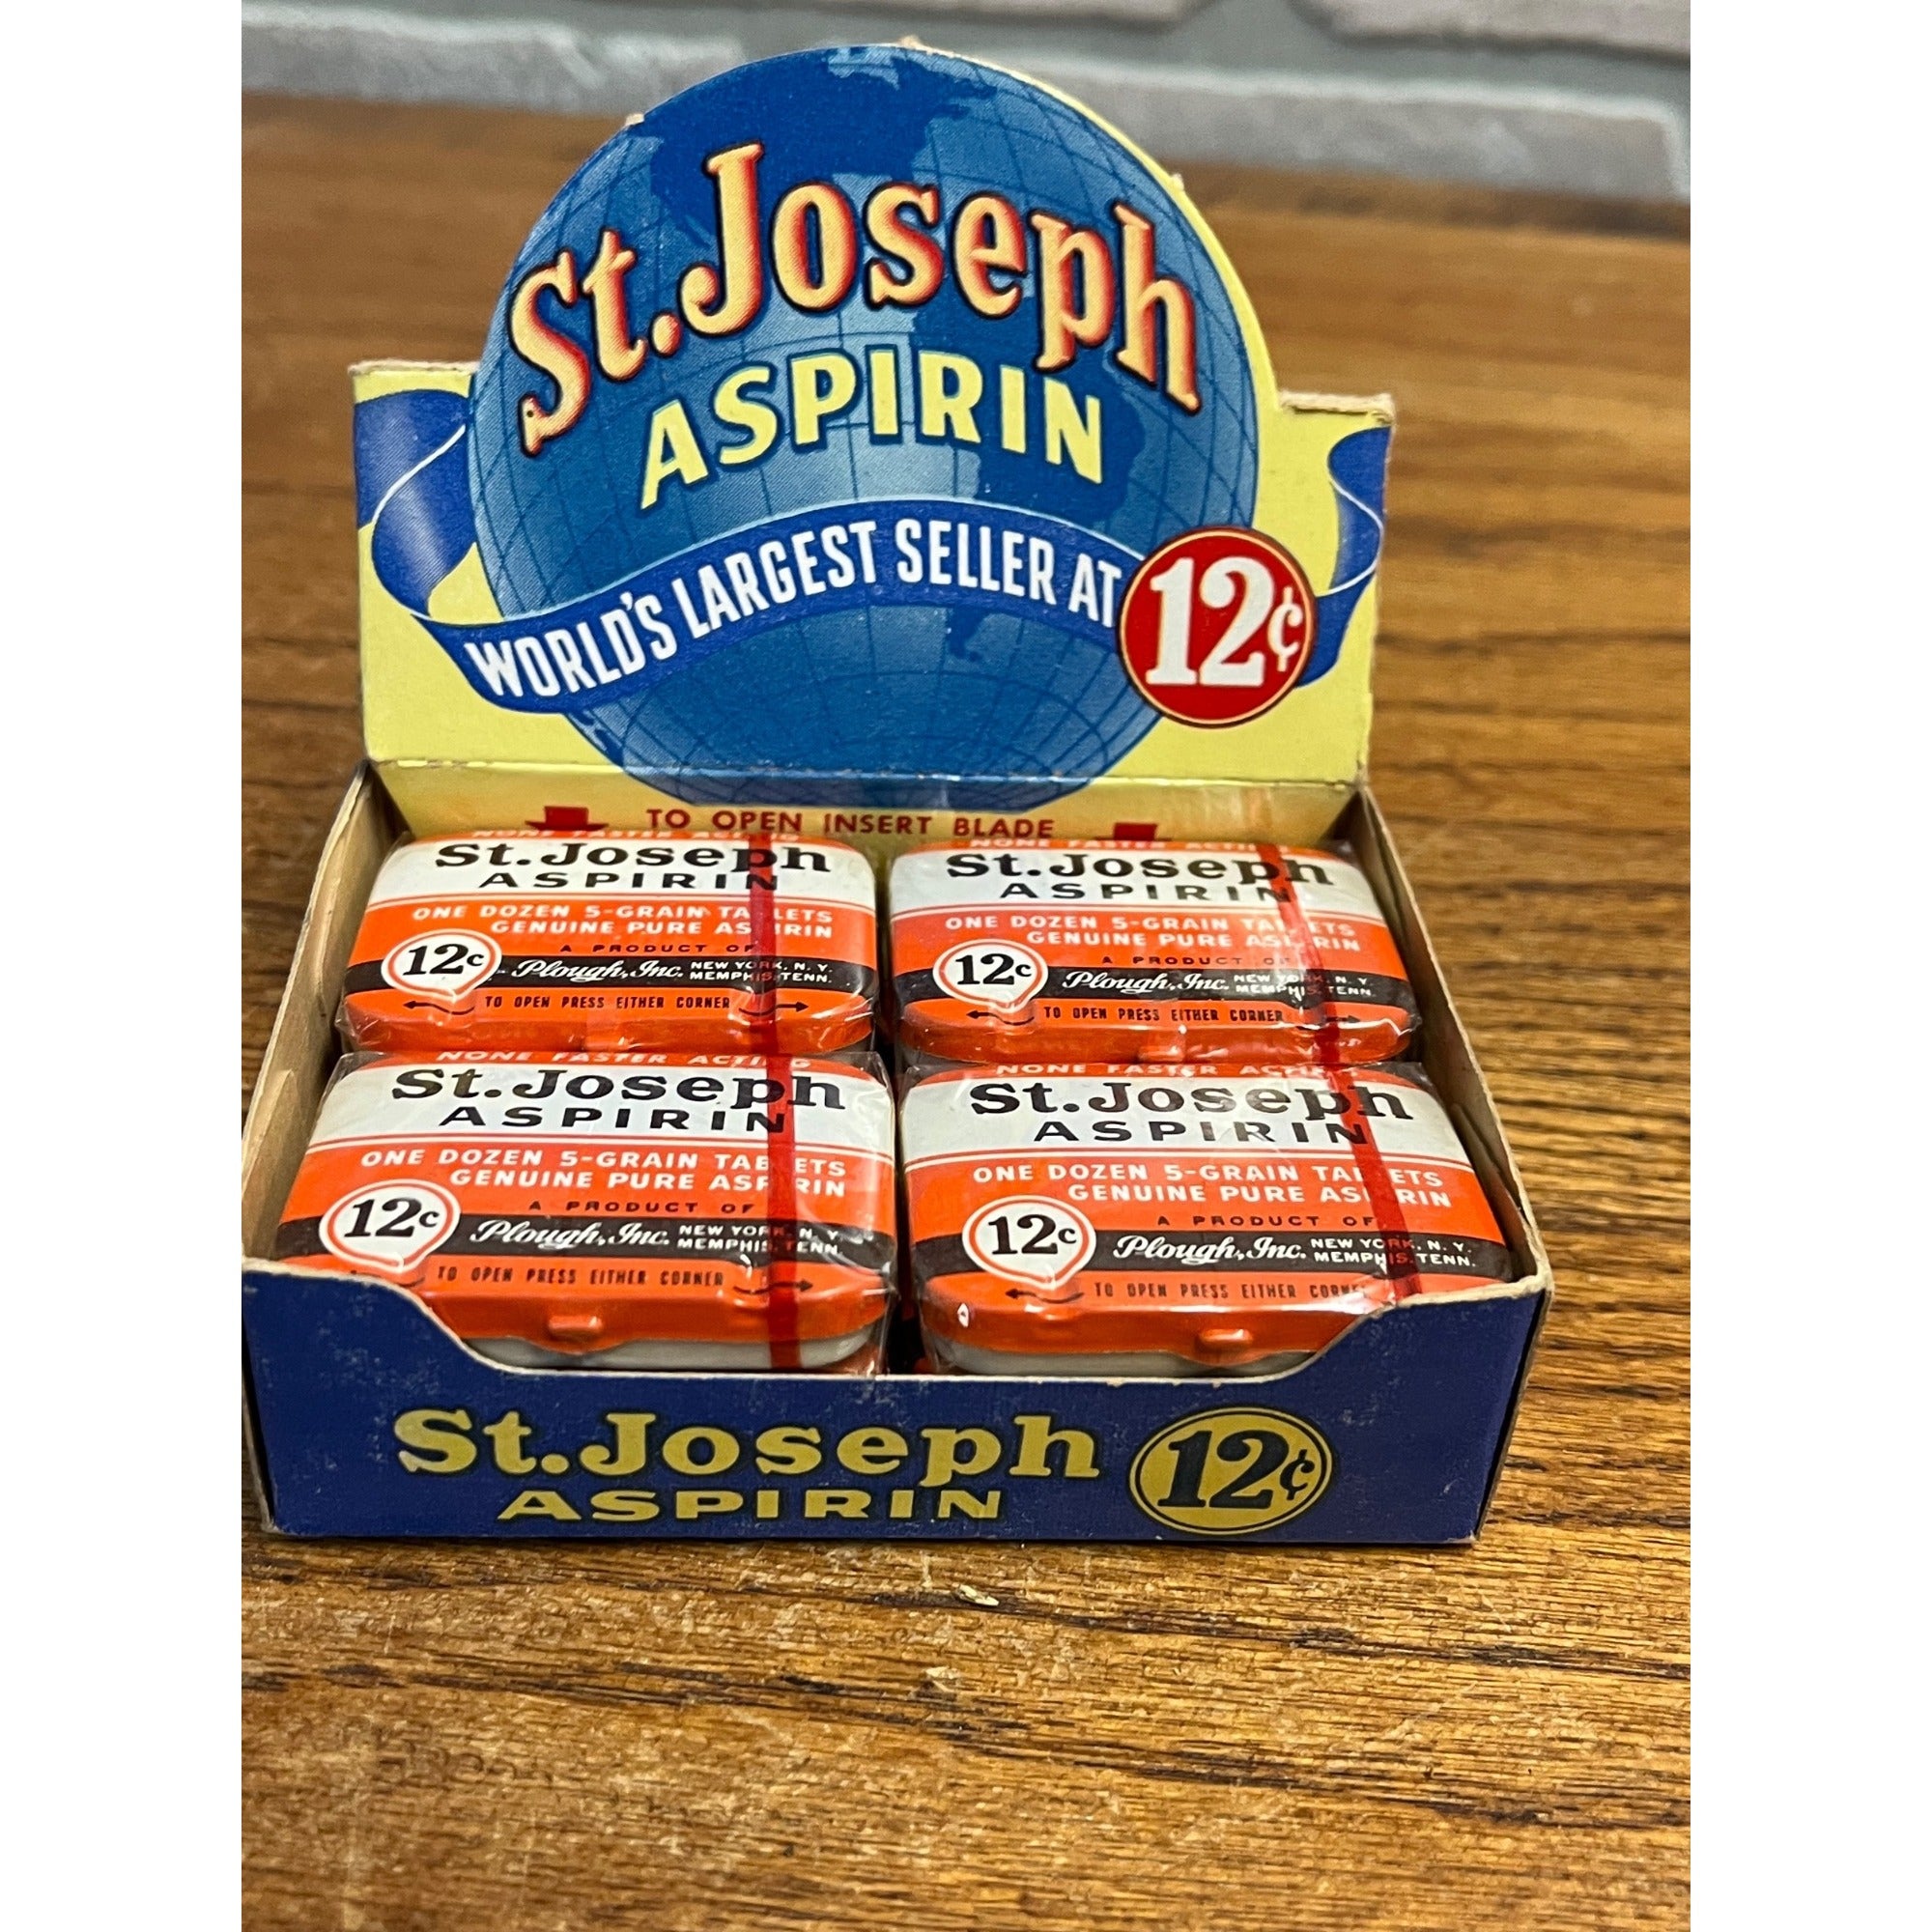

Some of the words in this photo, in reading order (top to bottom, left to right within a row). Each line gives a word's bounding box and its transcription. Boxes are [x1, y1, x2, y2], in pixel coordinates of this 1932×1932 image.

[639, 348, 1103, 511] ASPIRIN
[464, 592, 677, 696] WORLD'S
[671, 521, 877, 639] LARGEST
[895, 518, 1057, 606] SELLER
[1068, 553, 1122, 628] AT
[647, 809, 692, 830] TO
[712, 810, 803, 833] OPEN
[824, 813, 934, 835] INSERT
[952, 817, 1054, 838] BLADE
[478, 871, 778, 891] ASPIRIN
[1000, 883, 1292, 902] ASPIRIN
[412, 905, 468, 920] ONE
[480, 904, 570, 919] DOZEN
[584, 905, 706, 920] 5-GRAIN
[491, 921, 615, 934] GENUINE
[628, 921, 702, 935] PURE
[945, 916, 998, 929] ONE
[1010, 916, 1097, 929] DOZEN
[1112, 917, 1229, 930] 5-GRAIN
[1027, 931, 1147, 946] GENUINE
[1160, 933, 1233, 947] PURE
[560, 944, 572, 952] A
[592, 944, 707, 953] PRODUCT
[725, 944, 755, 953] OF
[691, 961, 728, 970] NEW
[1102, 955, 1113, 964] A
[1132, 955, 1241, 965] PRODUCT
[780, 972, 833, 984] TENN.
[1234, 974, 1271, 983] NEW
[486, 996, 502, 1009] TO
[514, 996, 551, 1009] OPEN
[561, 996, 605, 1009] PRESS
[616, 996, 665, 1009] EITHER
[676, 996, 730, 1009] CORNER
[1044, 1007, 1061, 1019] TO
[1072, 1007, 1108, 1020] OPEN
[1118, 1008, 1160, 1021] PRESS
[1172, 1009, 1219, 1022] EITHER
[1230, 1009, 1283, 1022] CORNER
[436, 1050, 532, 1062] NONE
[552, 1052, 668, 1064] FASTER
[996, 1064, 1087, 1074] NONE
[1107, 1064, 1219, 1076] FASTER
[439, 1106, 785, 1133] ASPIRIN
[1034, 1120, 1368, 1145] ASPIRIN
[360, 1149, 425, 1167] ONE
[438, 1149, 543, 1165] DOZEN
[559, 1151, 698, 1169] 5-GRAIN
[715, 1153, 846, 1177] TABETS
[973, 1164, 1034, 1183] ONE
[1048, 1164, 1148, 1180] DOZEN
[1164, 1165, 1299, 1182] 5-GRAIN
[449, 1169, 593, 1188] GENUINE
[607, 1172, 695, 1190] PURE
[708, 1174, 845, 1197] ASPRIN
[1067, 1184, 1207, 1202] GENUINE
[1220, 1185, 1305, 1203] PURE
[529, 1201, 541, 1210] A
[565, 1201, 698, 1212] PRODUCT
[721, 1204, 754, 1213] OF
[1157, 1215, 1171, 1226] A
[1192, 1215, 1320, 1227] PRODUCT
[1343, 1215, 1376, 1227] OF
[679, 1224, 724, 1236] NEW
[1311, 1237, 1353, 1249] NEW
[1416, 1252, 1477, 1268] TENN.
[438, 1265, 458, 1281] TO
[470, 1266, 514, 1282] OPEN
[526, 1267, 577, 1284] PRESS
[589, 1268, 646, 1285] EITHER
[660, 1269, 724, 1286] CORNER
[1094, 1282, 1114, 1297] TO
[1127, 1282, 1168, 1298] OPEN
[1180, 1283, 1229, 1299] PRESS
[1241, 1284, 1296, 1298] EITHER
[497, 1489, 1002, 1521] ASPIRIN
